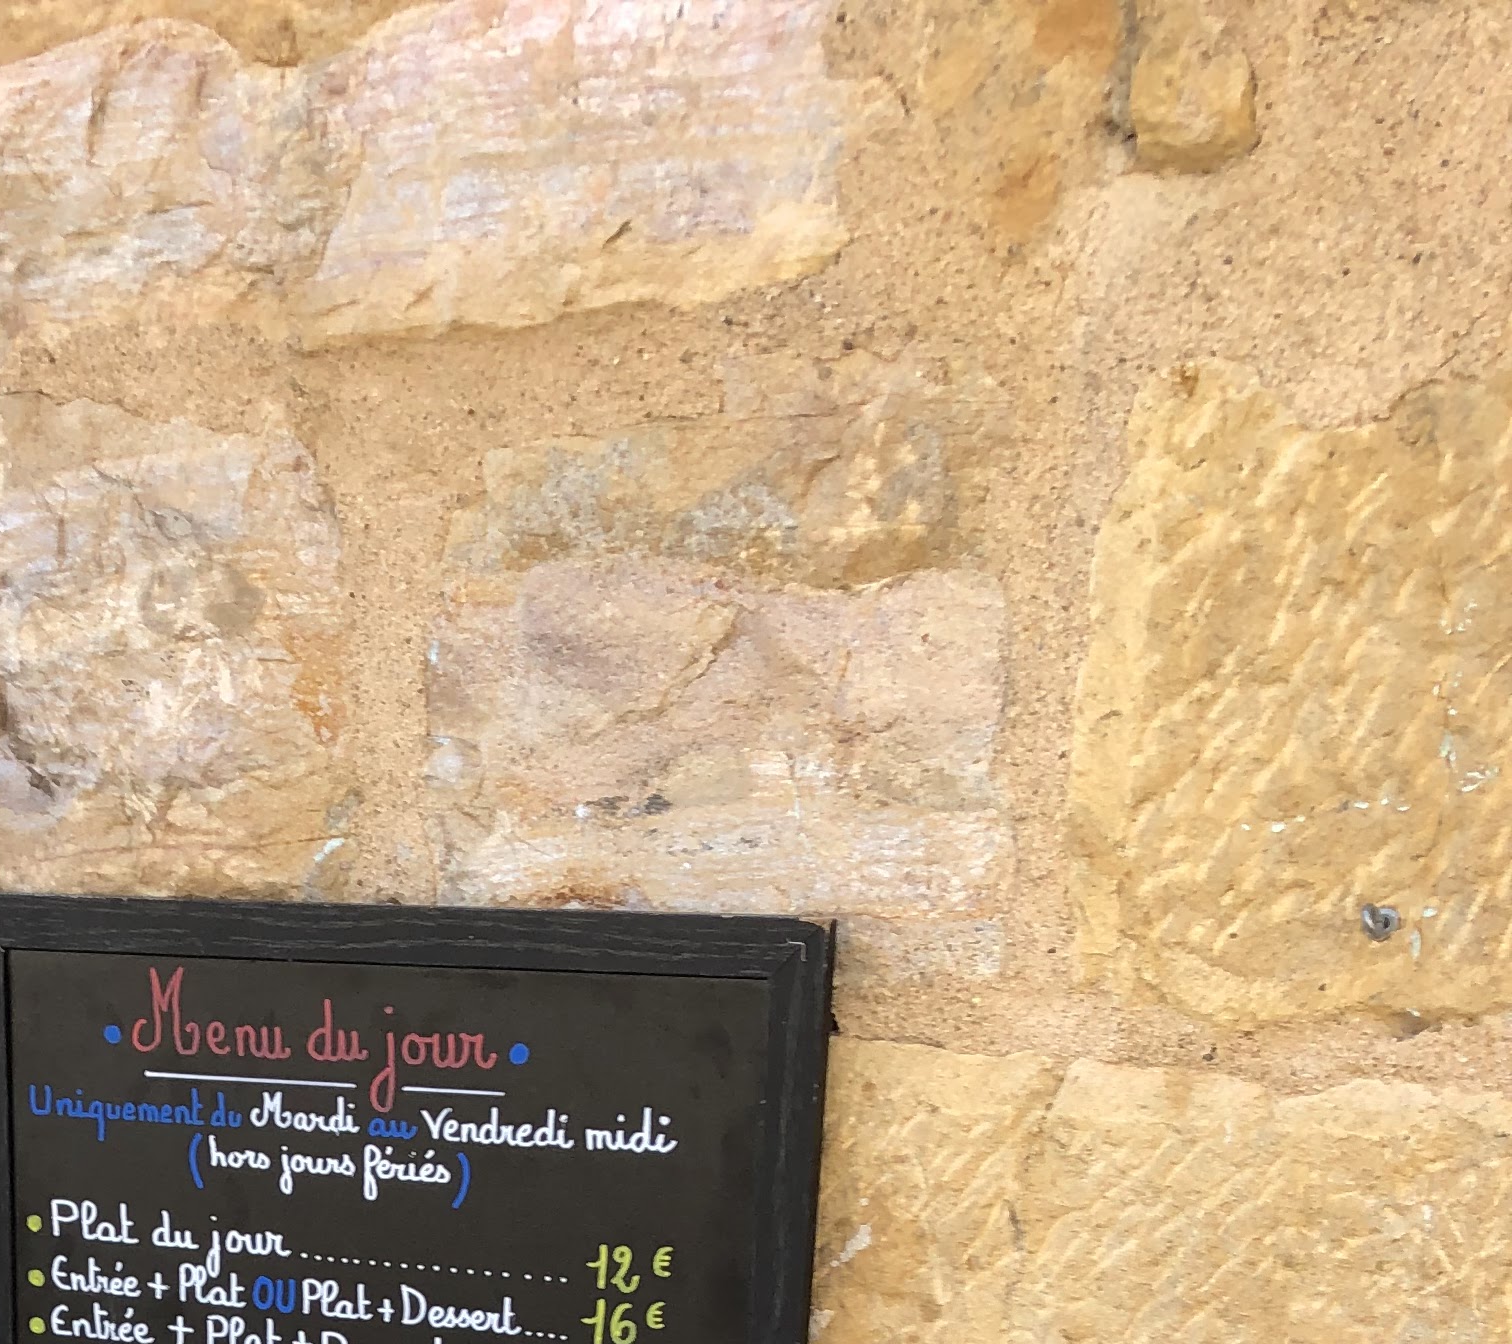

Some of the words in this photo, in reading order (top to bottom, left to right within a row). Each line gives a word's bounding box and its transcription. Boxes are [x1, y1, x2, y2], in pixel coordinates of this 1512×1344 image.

[132, 965, 291, 1064] Menu
[308, 998, 368, 1065] du
[369, 1007, 497, 1113] jour
[29, 1084, 205, 1141] Uniquement
[209, 1097, 243, 1130] du
[249, 1090, 360, 1134] Mardi
[368, 1116, 418, 1141] au
[420, 1108, 574, 1151] Vendredi
[584, 1114, 678, 1156] midi
[278, 1143, 356, 1197] jours
[49, 1200, 139, 1247] Plat
[151, 1211, 200, 1252] du
[204, 1218, 293, 1277] jour
[50, 1256, 141, 1300] Entrée
[177, 1267, 247, 1310] Plat
[251, 1275, 297, 1315] OU
[301, 1278, 374, 1321] Plat
[49, 1304, 155, 1344] Entrée
